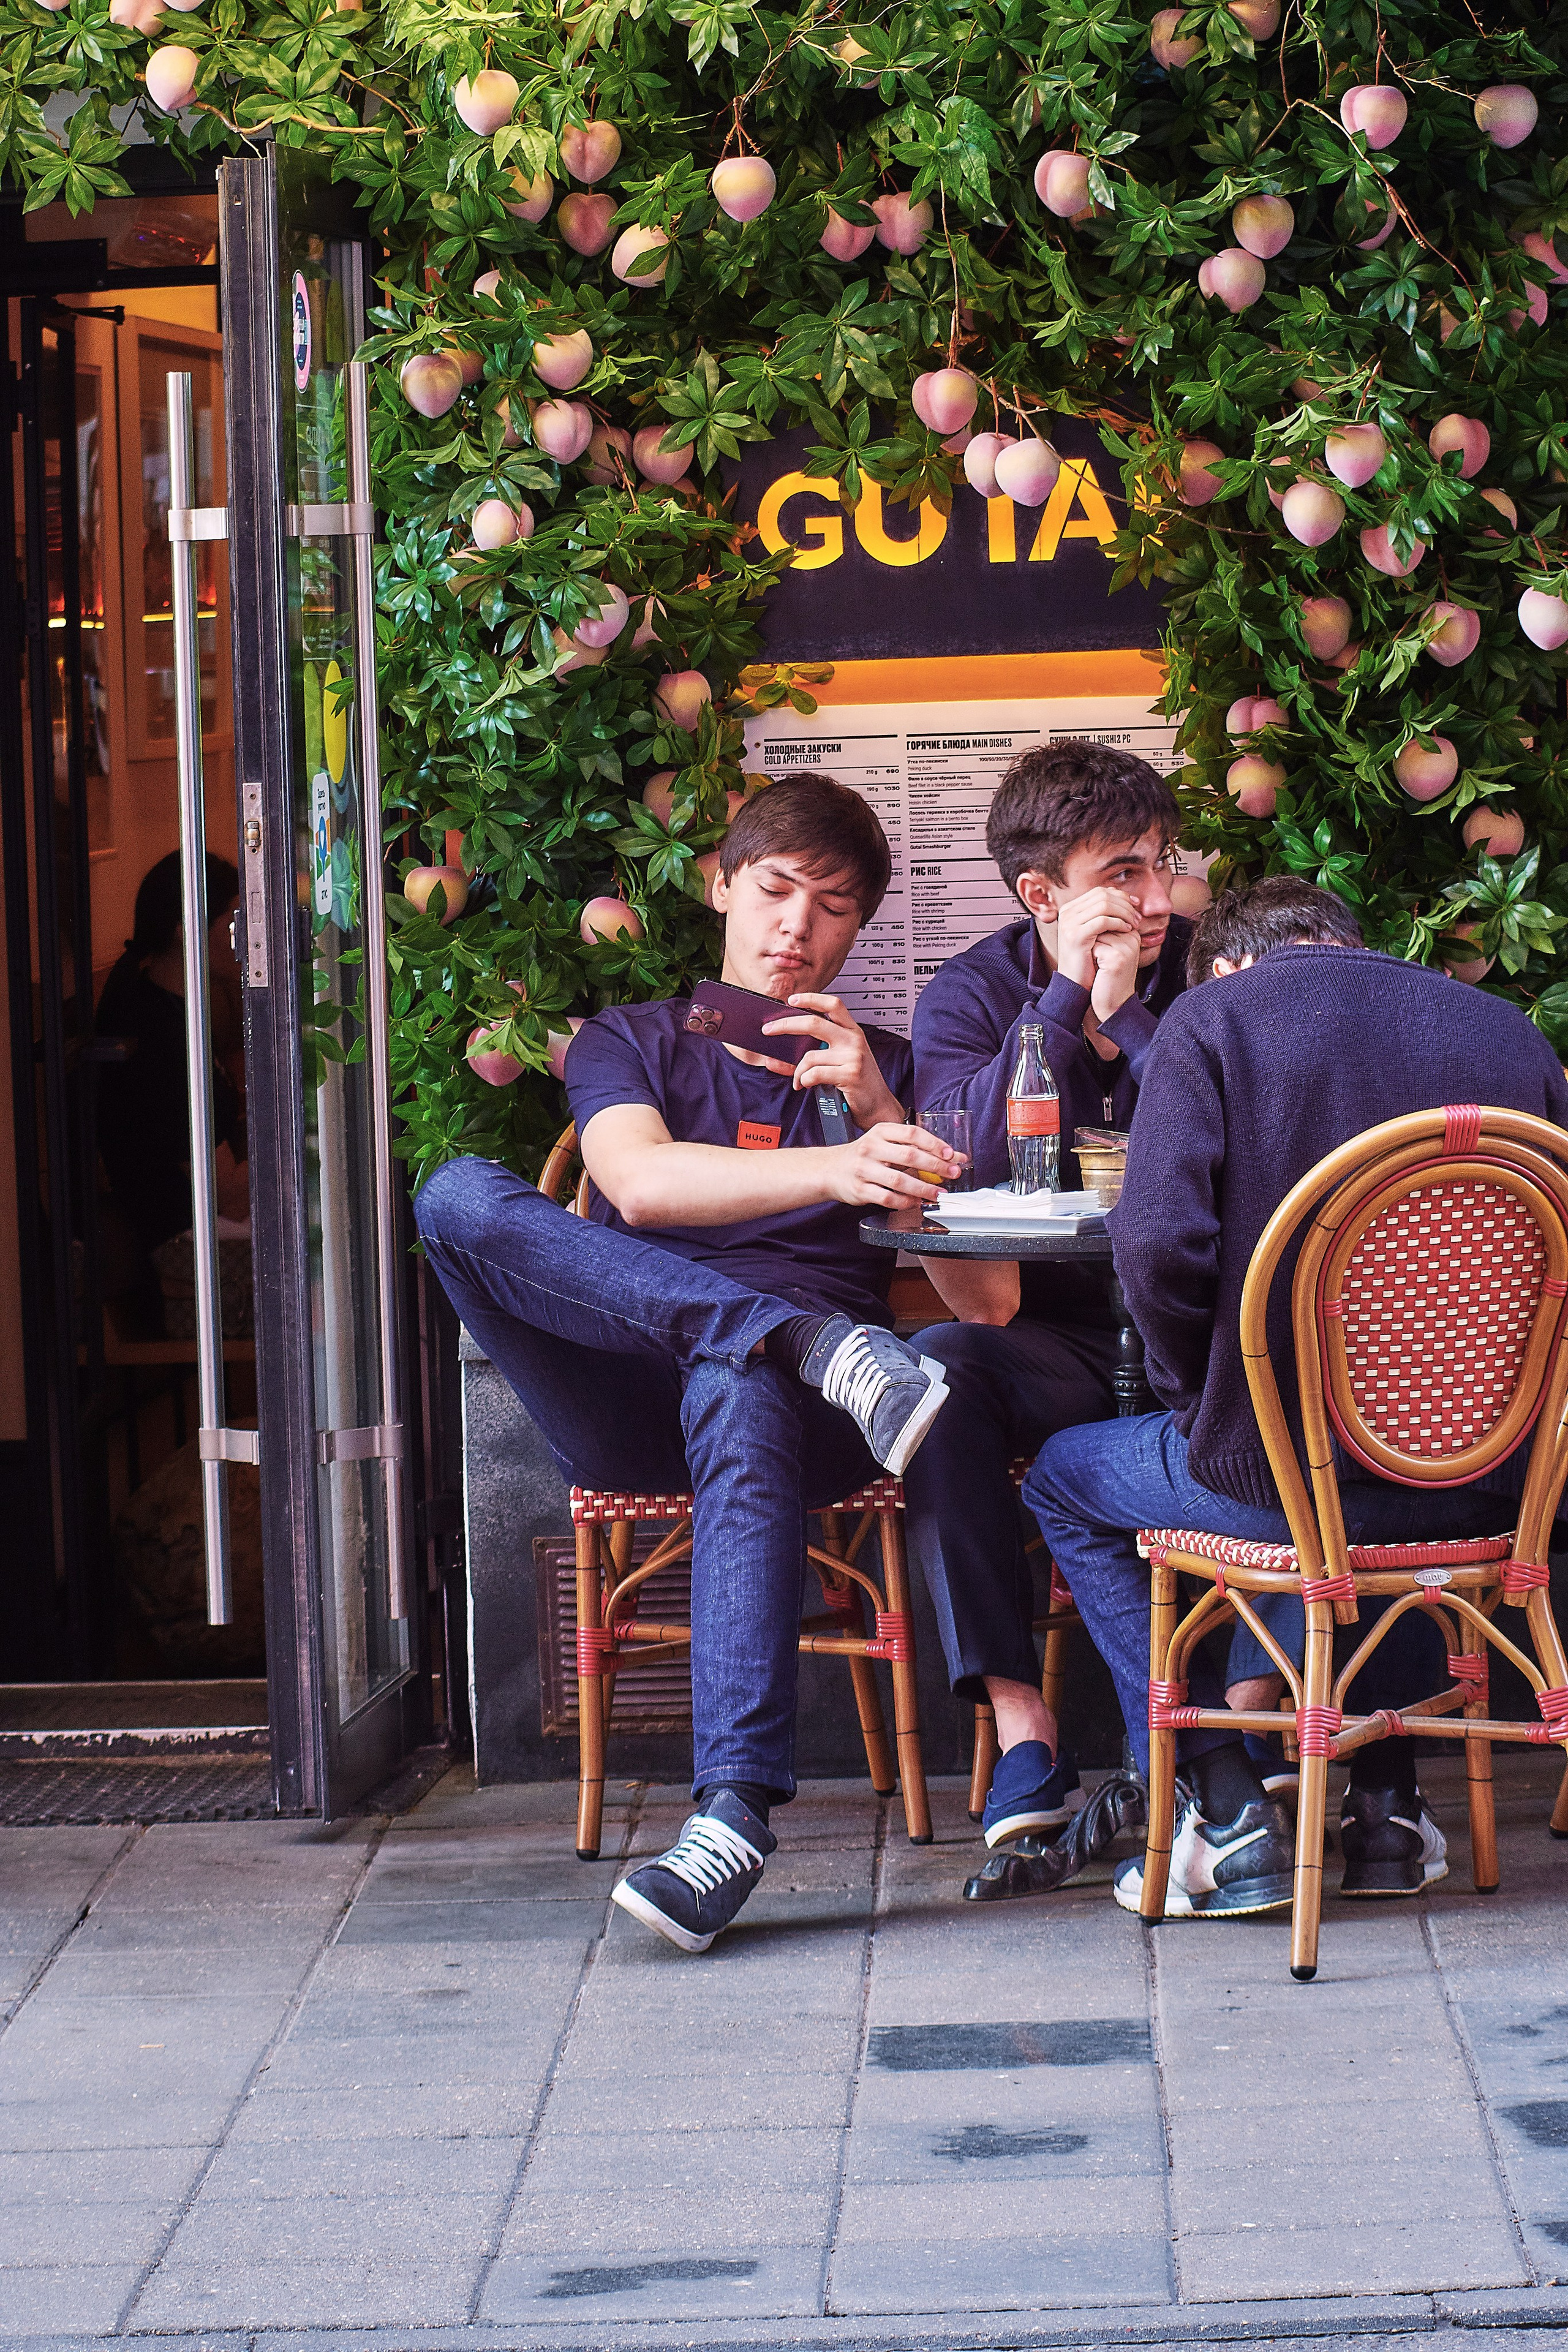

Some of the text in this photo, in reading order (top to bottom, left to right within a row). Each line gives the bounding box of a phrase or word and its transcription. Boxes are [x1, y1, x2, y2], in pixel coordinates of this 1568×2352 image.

[1123, 734, 1131, 743] PC
[907, 738, 1012, 750] ГОРЯЧИЕ БЛЮДА MAIN DISHES
[764, 744, 841, 756] ХОЛОДНЫЕ ЗАКУСКИ
[764, 754, 821, 764] COLD APPETIZERS
[910, 866, 941, 876] РИС RICE
[745, 1133, 772, 1144] HUGO
[1423, 1573, 1443, 1583] may
